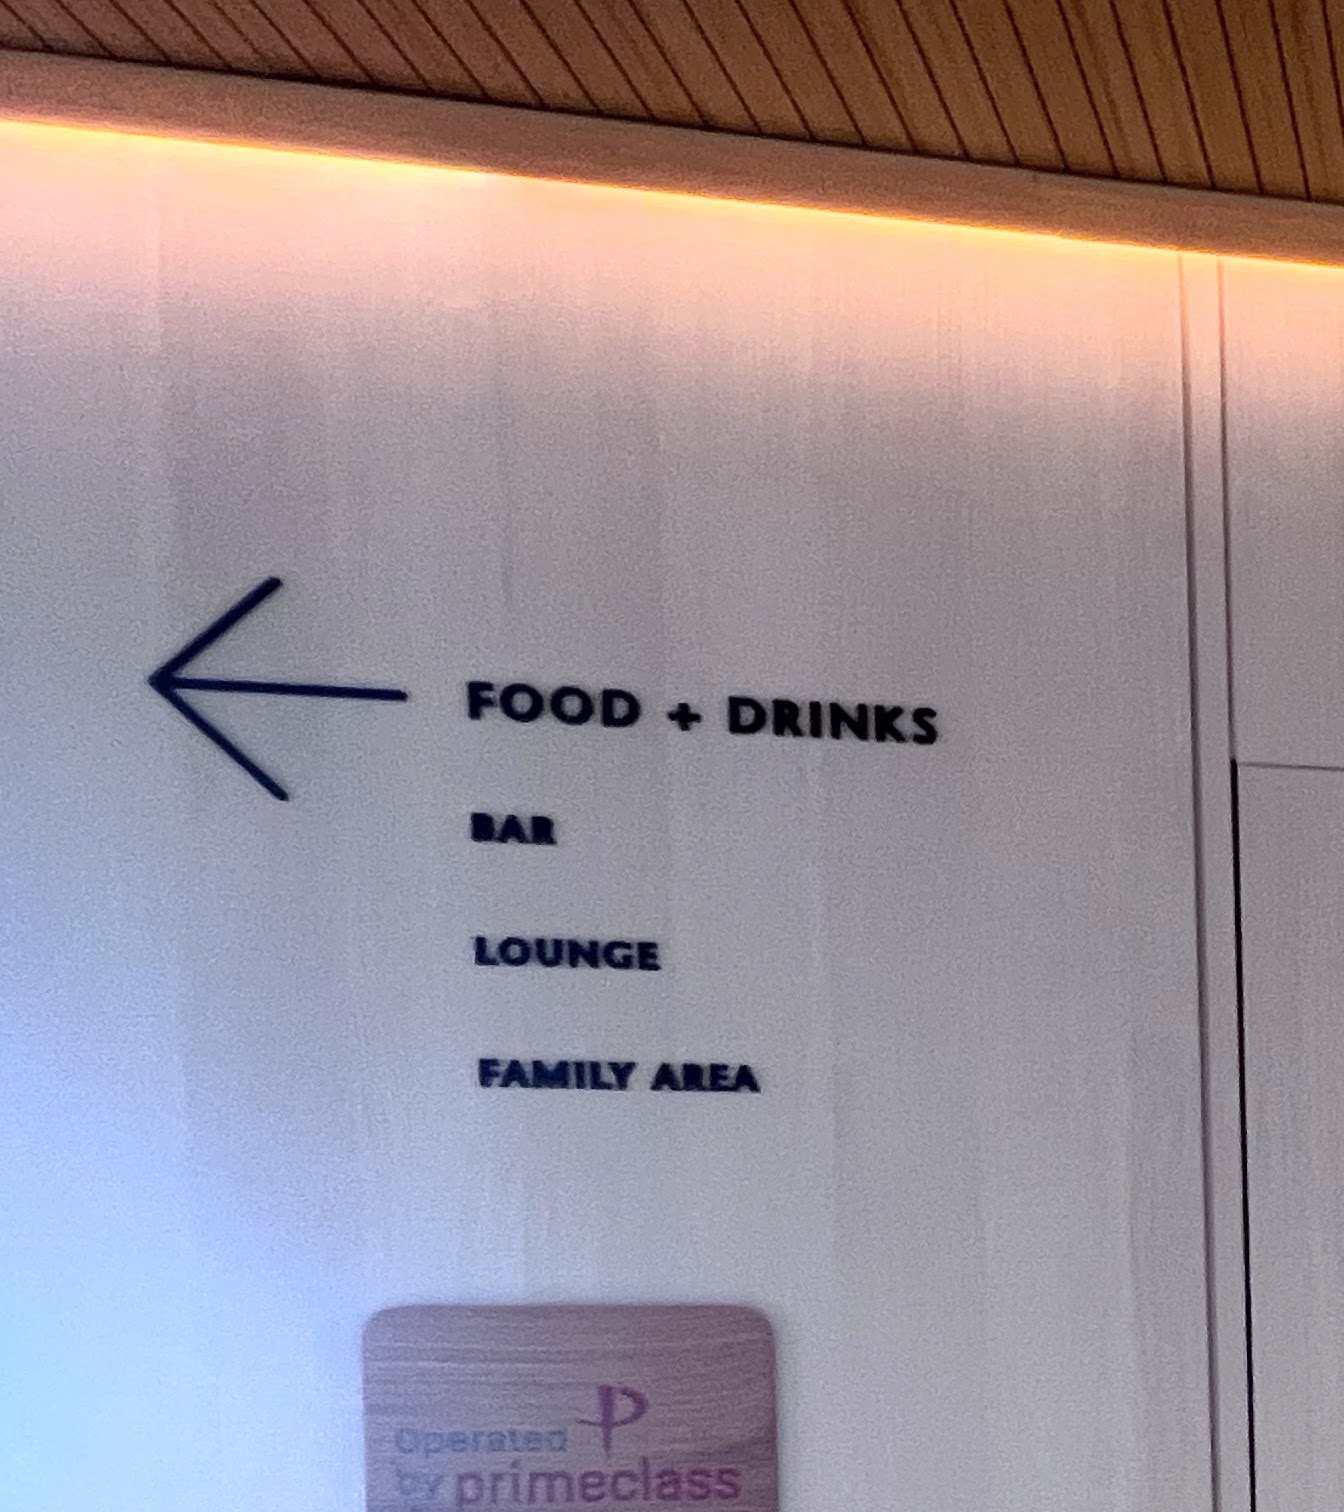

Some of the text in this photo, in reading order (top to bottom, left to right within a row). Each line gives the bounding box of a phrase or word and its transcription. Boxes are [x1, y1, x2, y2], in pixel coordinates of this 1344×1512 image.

[467, 681, 938, 745] FOOD + DRINKS
[470, 812, 556, 845] BAR
[473, 936, 661, 971] LOUNGE
[478, 1058, 761, 1092] FAMILY AREA
[396, 1428, 568, 1458] Operated
[455, 1457, 741, 1511] primeclass
